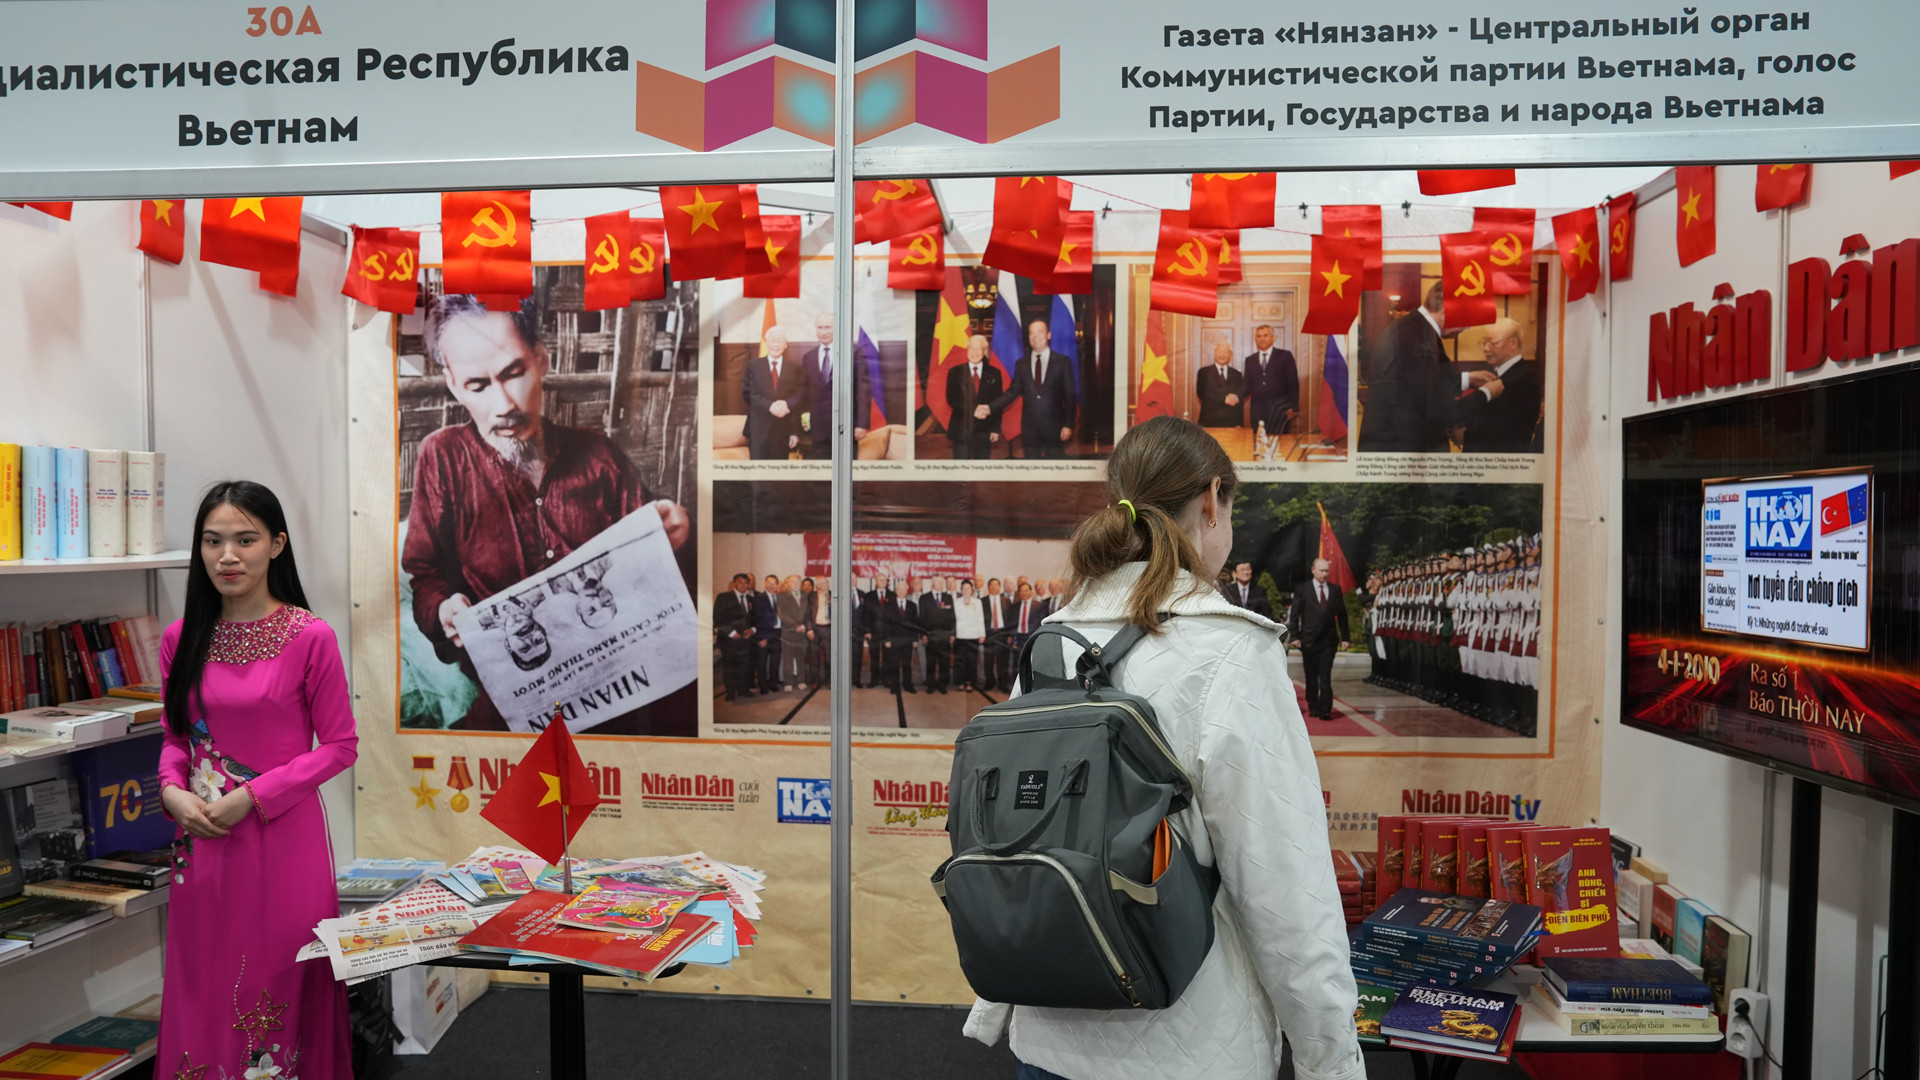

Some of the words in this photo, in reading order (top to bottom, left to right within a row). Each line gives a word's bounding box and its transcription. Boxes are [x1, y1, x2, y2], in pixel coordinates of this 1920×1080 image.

[1163, 24, 1265, 48] Газета
[1274, 22, 1438, 44] «Нянзан»
[1470, 6, 1699, 45] Центральный
[1710, 11, 1810, 39] орган
[357, 37, 629, 87] Республика
[1121, 55, 1438, 93] Коммунистической
[1450, 62, 1566, 87] партии
[1577, 56, 1746, 81] Вьетнама,
[1757, 52, 1857, 75] голос
[1149, 105, 1275, 131] Партии,
[1286, 102, 1489, 131] Государства
[1501, 103, 1519, 123] и
[1531, 101, 1652, 127] народа
[1664, 95, 1825, 119] Вьетнама
[179, 114, 358, 147] Вьетнам
[1647, 282, 1772, 402] Nhân
[1785, 233, 1920, 373] Dân
[1750, 521, 1812, 547] NAY
[1747, 574, 1761, 599] Nơi
[1763, 570, 1785, 602] tuyến
[1788, 570, 1803, 602] đầu
[1806, 571, 1833, 607] chống
[1837, 578, 1858, 612] dịch
[1818, 627, 1828, 636] sau
[1750, 663, 1767, 685] Ra
[1771, 665, 1788, 689] số
[1749, 689, 1775, 714] Báo
[1778, 694, 1819, 725] THỜI
[1825, 705, 1866, 734] NAY
[586, 761, 622, 796] ân
[641, 773, 692, 796] Nhân
[695, 775, 735, 797] Dân
[873, 779, 927, 803] Nhân
[782, 799, 831, 818] NA
[1402, 788, 1461, 815] Nhân
[1465, 790, 1510, 816] Dân
[1511, 794, 1542, 821] tv
[1578, 869, 1596, 877] ANH
[1548, 914, 1568, 926] ĐIỆN
[1570, 913, 1589, 923] BIÊN
[1612, 986, 1672, 1001] ВЬЕТНАМ
